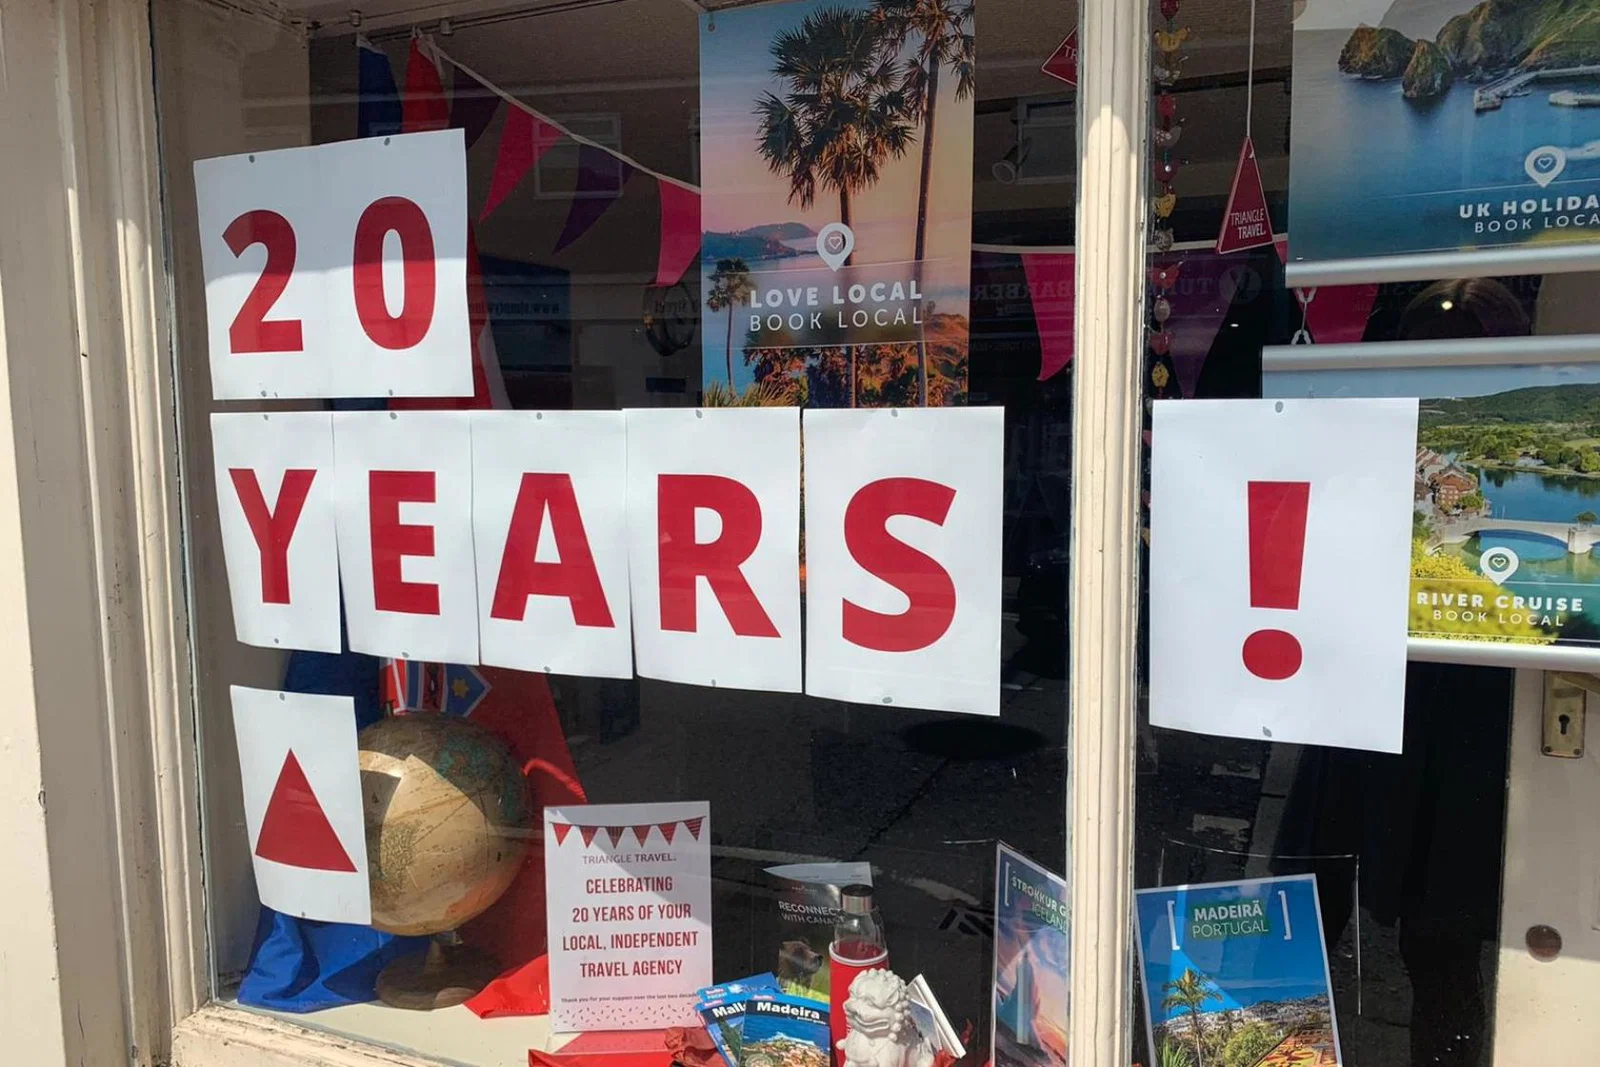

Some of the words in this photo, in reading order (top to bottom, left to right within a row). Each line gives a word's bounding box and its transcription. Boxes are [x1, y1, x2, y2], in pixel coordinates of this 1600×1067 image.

[1459, 202, 1491, 218] UK
[1502, 194, 1600, 216] HOLIDA
[1230, 208, 1265, 227] TRIANGLE
[1475, 217, 1532, 233] BOOK
[1544, 213, 1600, 228] LOCA
[221, 195, 437, 355] 20
[750, 287, 819, 309] LOVE
[832, 280, 923, 304] LOCAL
[750, 312, 822, 332] BOOK
[838, 306, 923, 329] LOCAL
[228, 467, 957, 653] YEARS
[1417, 592, 1484, 608] RIVER
[1495, 595, 1583, 612] CRUISE
[1433, 609, 1487, 622] BOOK
[1499, 613, 1564, 627] LOCAL
[582, 854, 632, 865] TRIANGLE
[585, 876, 673, 894] CELEBRATING
[572, 907, 589, 923] 20
[593, 905, 634, 922] YEARS
[638, 904, 654, 920] OF
[658, 903, 692, 919] YOUR
[782, 913, 805, 922] WITH
[806, 916, 845, 925] CANA
[1192, 920, 1269, 938] PORTUGAL
[562, 934, 607, 951] LOCAL,
[611, 931, 699, 949] INDEPENDENT
[580, 962, 629, 978] TRAVEL
[632, 959, 683, 976] AGENCY
[711, 1002, 746, 1018] Mall
[756, 1002, 820, 1020] Madeira
